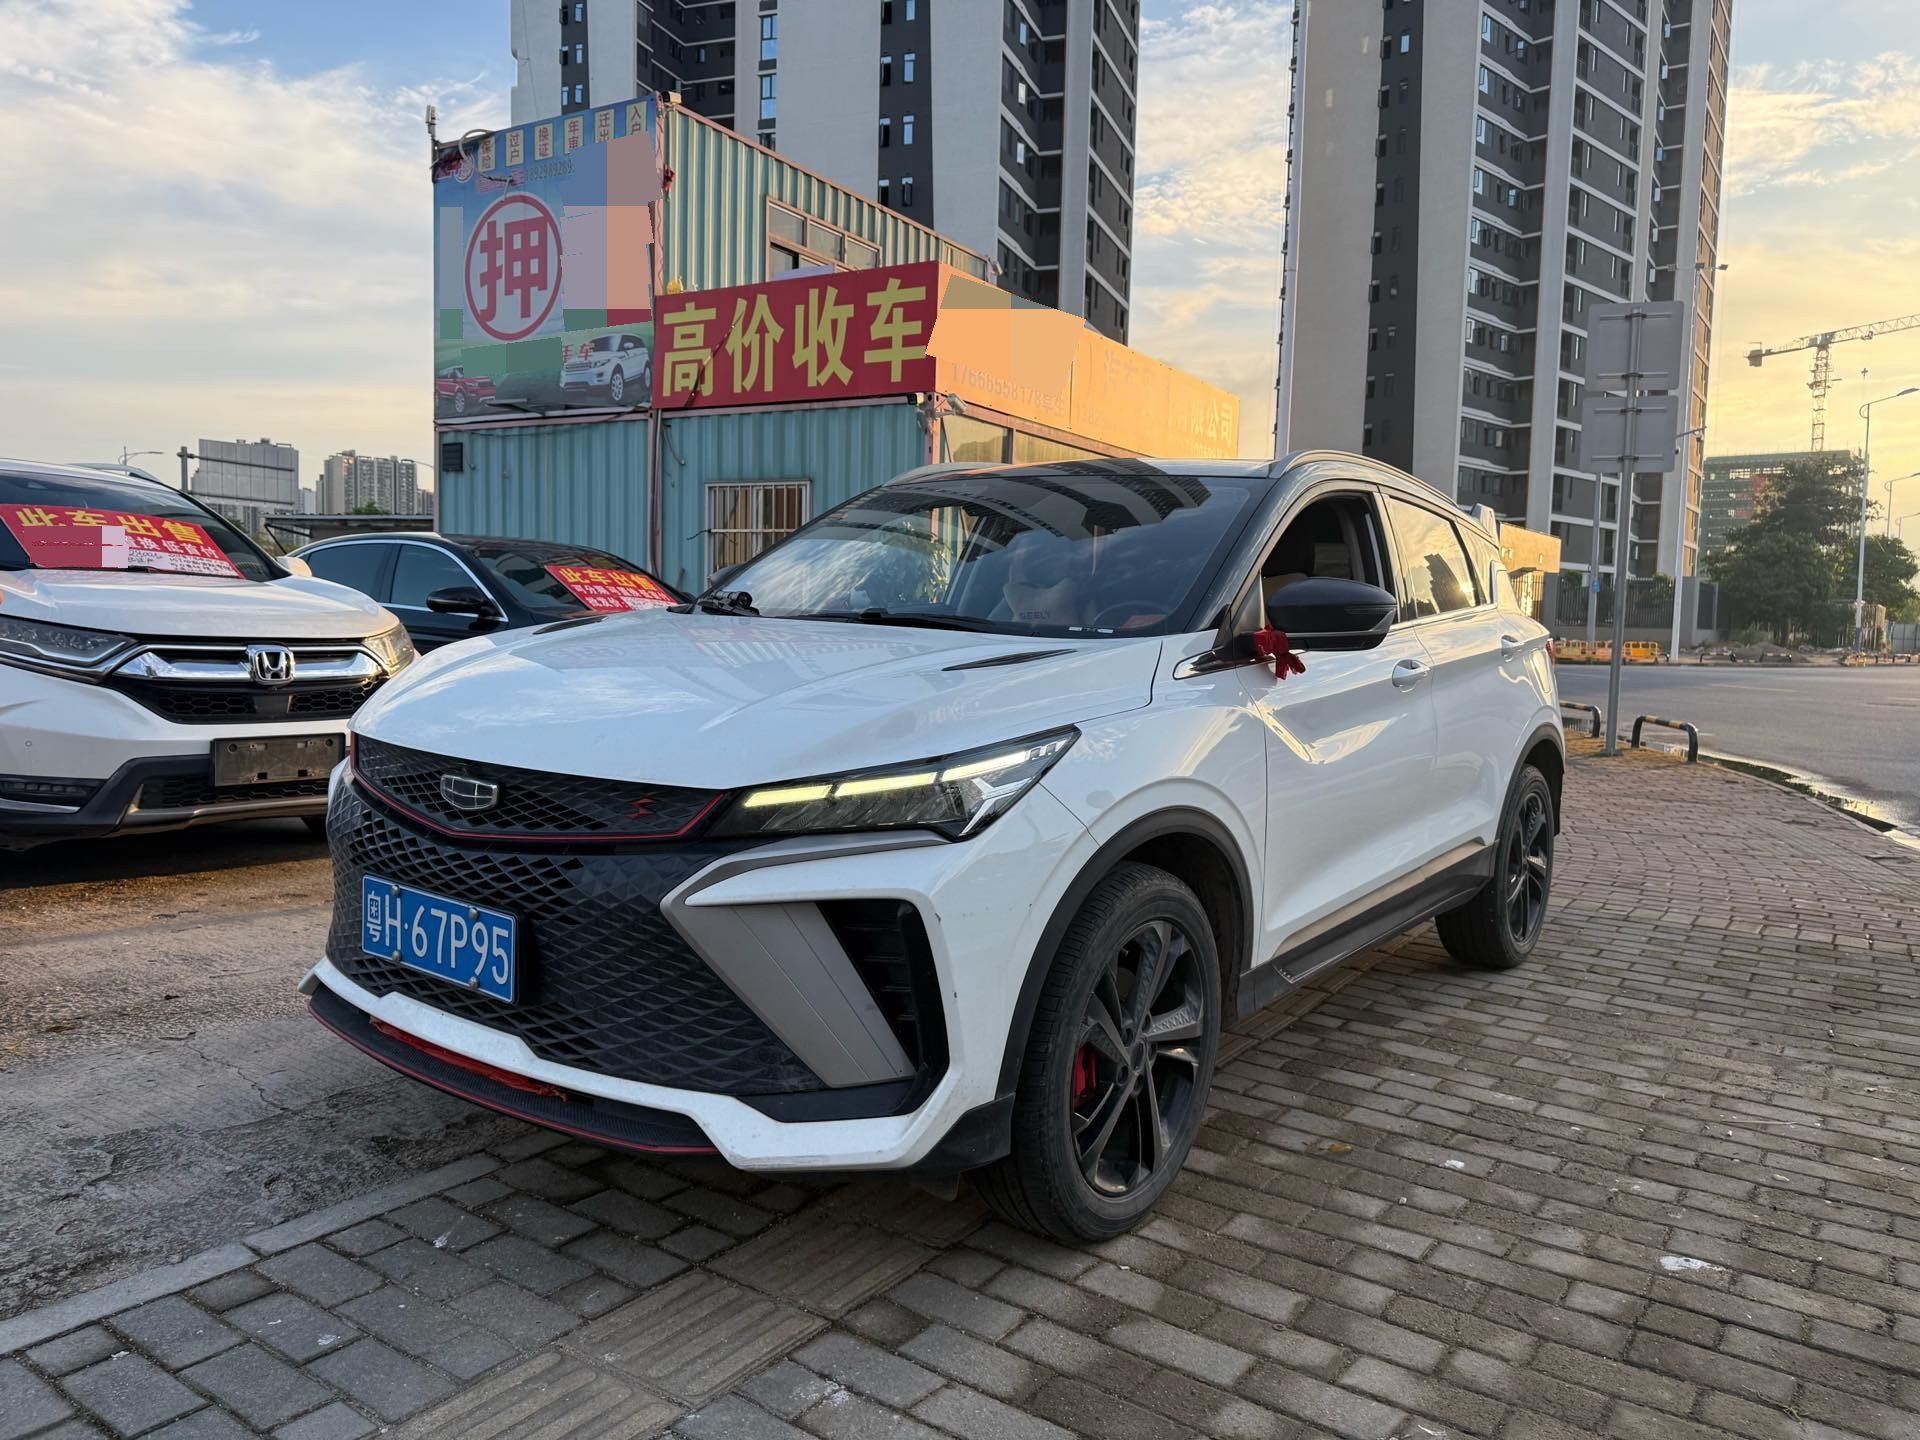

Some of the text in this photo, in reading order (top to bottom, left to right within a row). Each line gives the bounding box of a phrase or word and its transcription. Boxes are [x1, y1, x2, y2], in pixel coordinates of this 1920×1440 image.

[509, 133, 520, 164] 过户
[479, 216, 548, 323] 押
[662, 278, 927, 397] 高价收车
[16, 507, 204, 545] 此车出售
[559, 568, 656, 592] 此车出售
